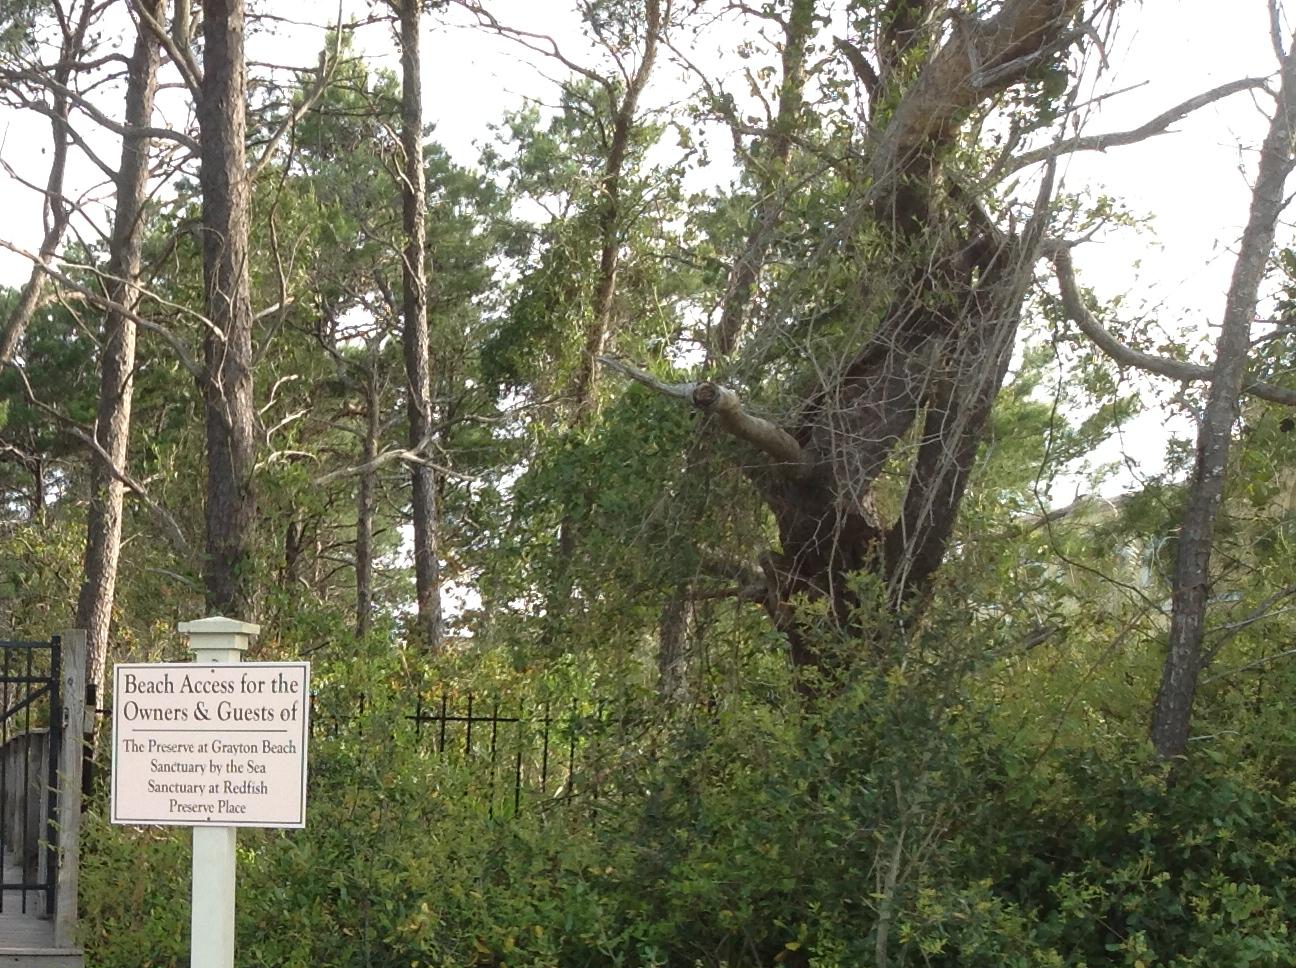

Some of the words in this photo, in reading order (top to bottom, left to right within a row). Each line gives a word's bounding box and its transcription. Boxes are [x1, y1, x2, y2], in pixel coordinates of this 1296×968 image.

[124, 673, 175, 694] Beach
[179, 673, 235, 694] Access
[240, 672, 266, 694] for
[271, 672, 299, 694] the
[123, 700, 189, 721] Owners
[193, 700, 212, 721] &
[217, 700, 275, 722] Guests
[280, 700, 299, 722] of
[122, 739, 145, 753] The
[148, 739, 195, 754] Preserve
[197, 742, 208, 754] at
[211, 739, 258, 756] Grayton
[261, 739, 297, 754] Beach
[150, 758, 206, 776] Sanctuary
[209, 760, 223, 776] by
[225, 759, 244, 774] the
[247, 759, 266, 774] Sea
[147, 779, 206, 796] Sanctuary
[208, 782, 220, 794] at
[223, 780, 268, 795] Redfish
[169, 799, 215, 814] Preserve
[217, 799, 247, 814] Place
